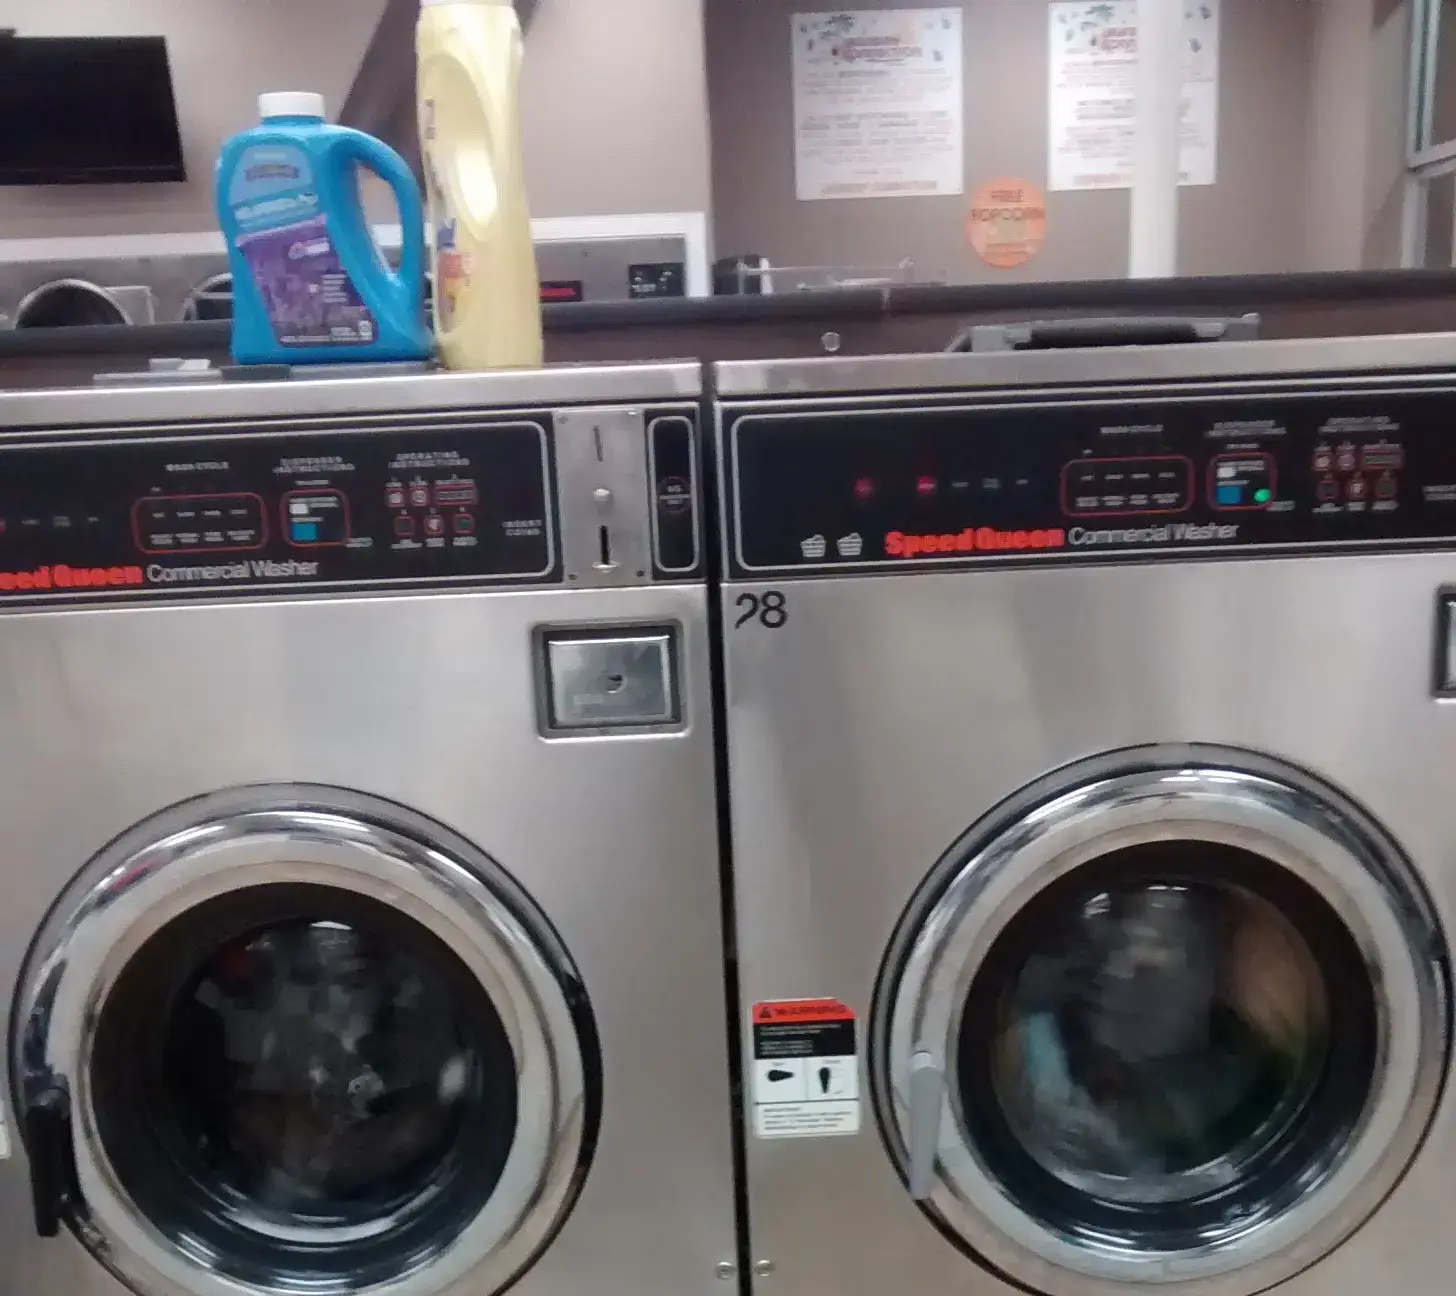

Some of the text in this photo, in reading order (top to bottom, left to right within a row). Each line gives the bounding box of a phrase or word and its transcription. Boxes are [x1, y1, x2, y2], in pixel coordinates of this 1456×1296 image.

[884, 520, 1240, 557] Speed Queen Commercial Washer
[0, 559, 319, 590] eed Queen Commercial Washer
[735, 590, 789, 630] 28
